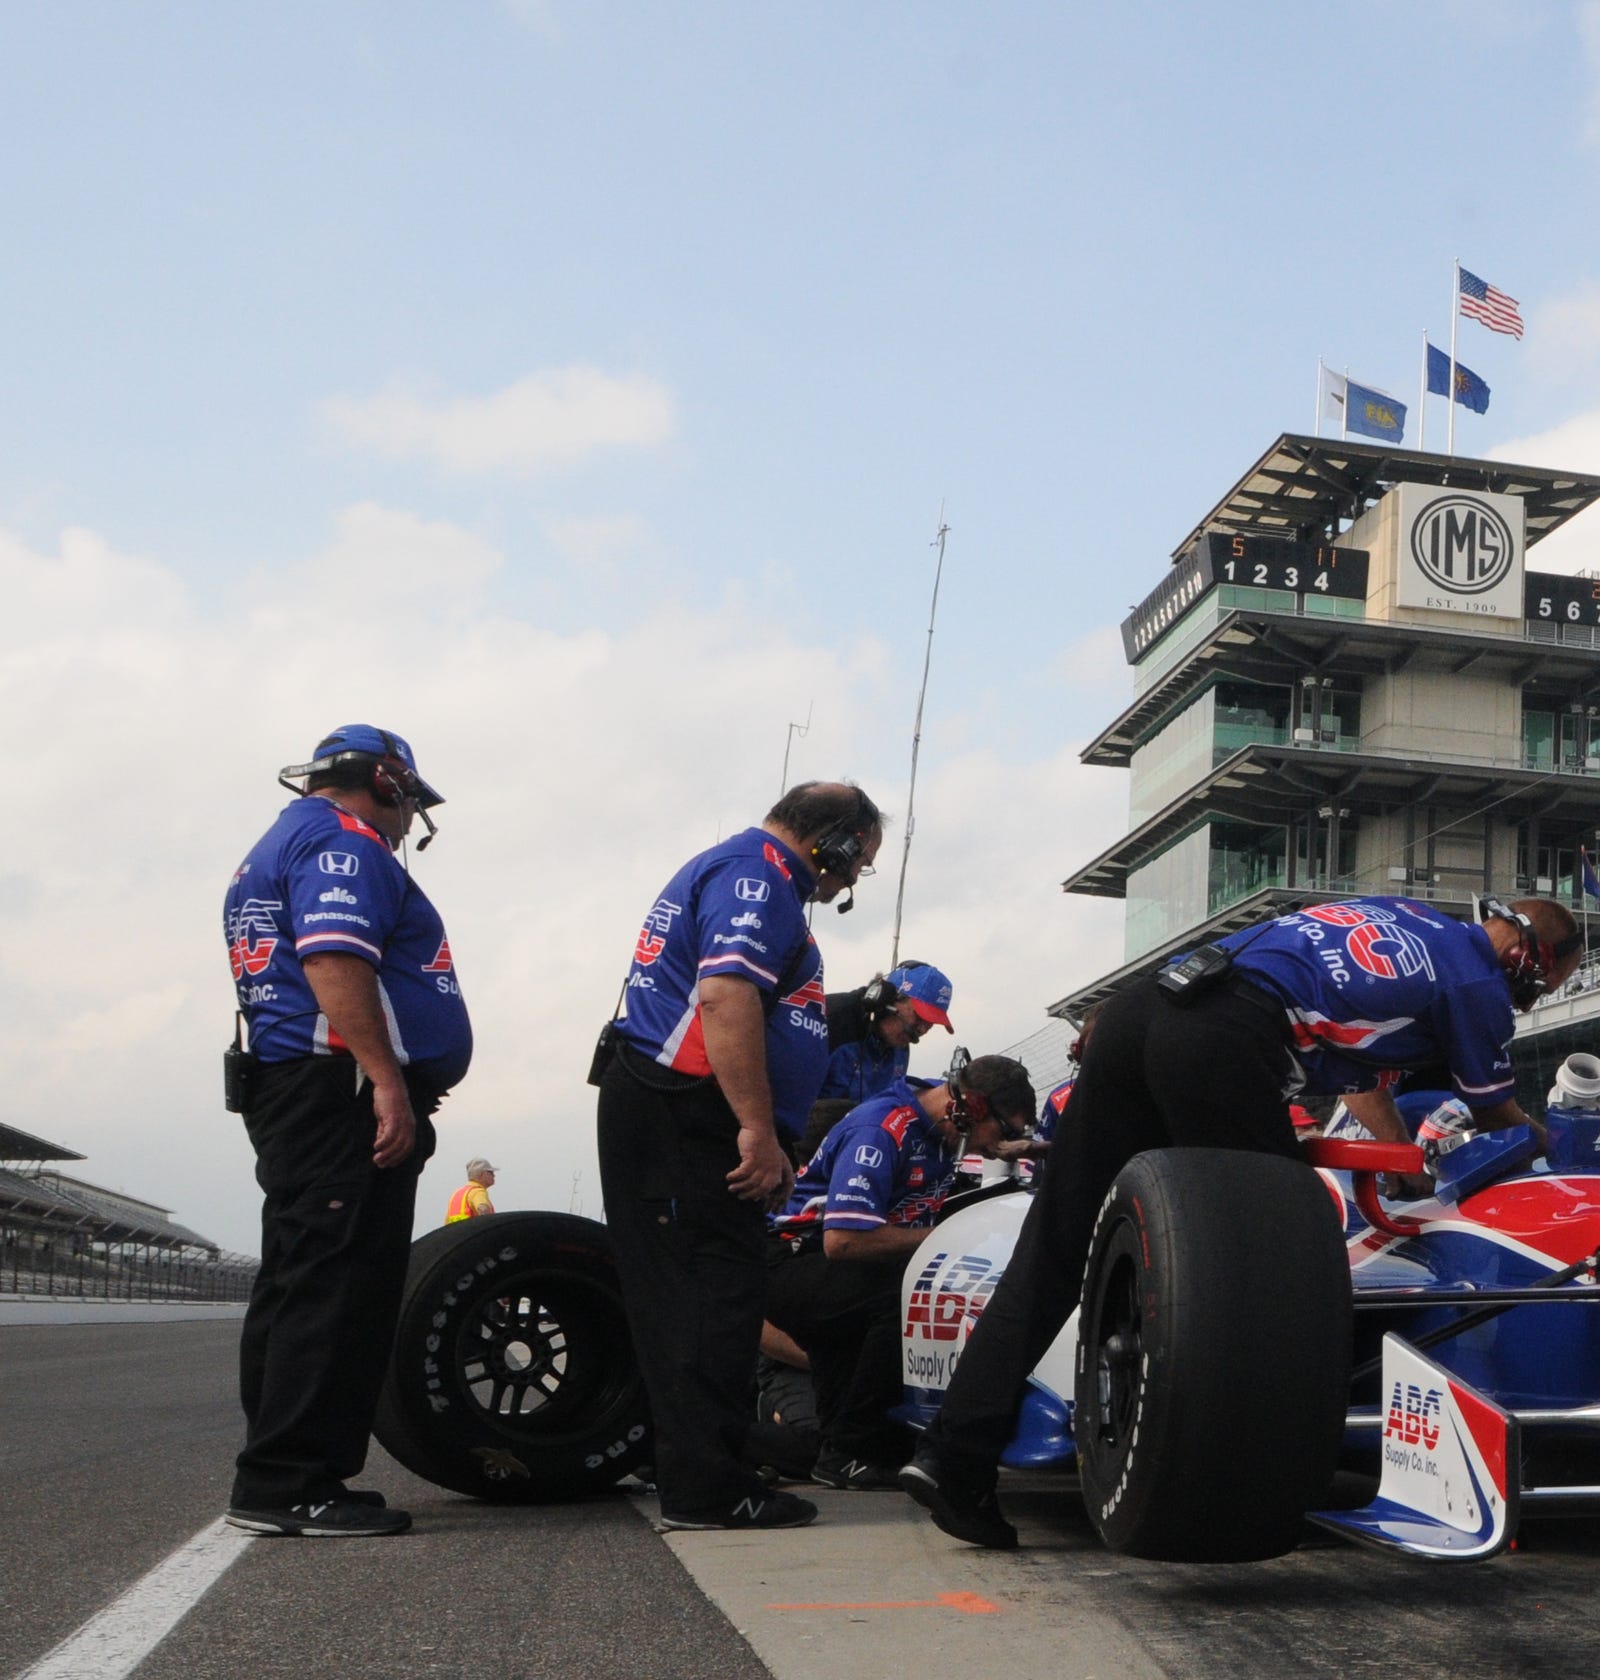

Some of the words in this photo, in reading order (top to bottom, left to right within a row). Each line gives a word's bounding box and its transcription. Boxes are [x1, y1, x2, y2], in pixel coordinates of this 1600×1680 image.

[1232, 537, 1244, 557] 5
[1317, 547, 1337, 568] 11
[1430, 508, 1500, 581] IMS
[1224, 560, 1236, 581] 1
[1253, 563, 1269, 585] 2
[1285, 567, 1299, 588] 3
[1314, 571, 1329, 592] 4
[1426, 597, 1457, 609] EST.
[1465, 602, 1497, 614] 1909
[1539, 598, 1552, 616] 5
[1567, 601, 1581, 620] 6
[304, 911, 371, 928] Panasonic
[713, 933, 767, 953] Panasonic
[1297, 922, 1326, 946] Co.
[1319, 948, 1351, 990] inc.
[1302, 898, 1436, 982] BC
[789, 1008, 829, 1039] Supp
[424, 1246, 518, 1413] Firestone
[908, 1348, 944, 1385] Supply
[1383, 1381, 1443, 1451] ABC
[1385, 1443, 1410, 1471] Supply
[1412, 1452, 1424, 1472] Co.
[1425, 1455, 1440, 1477] inc.
